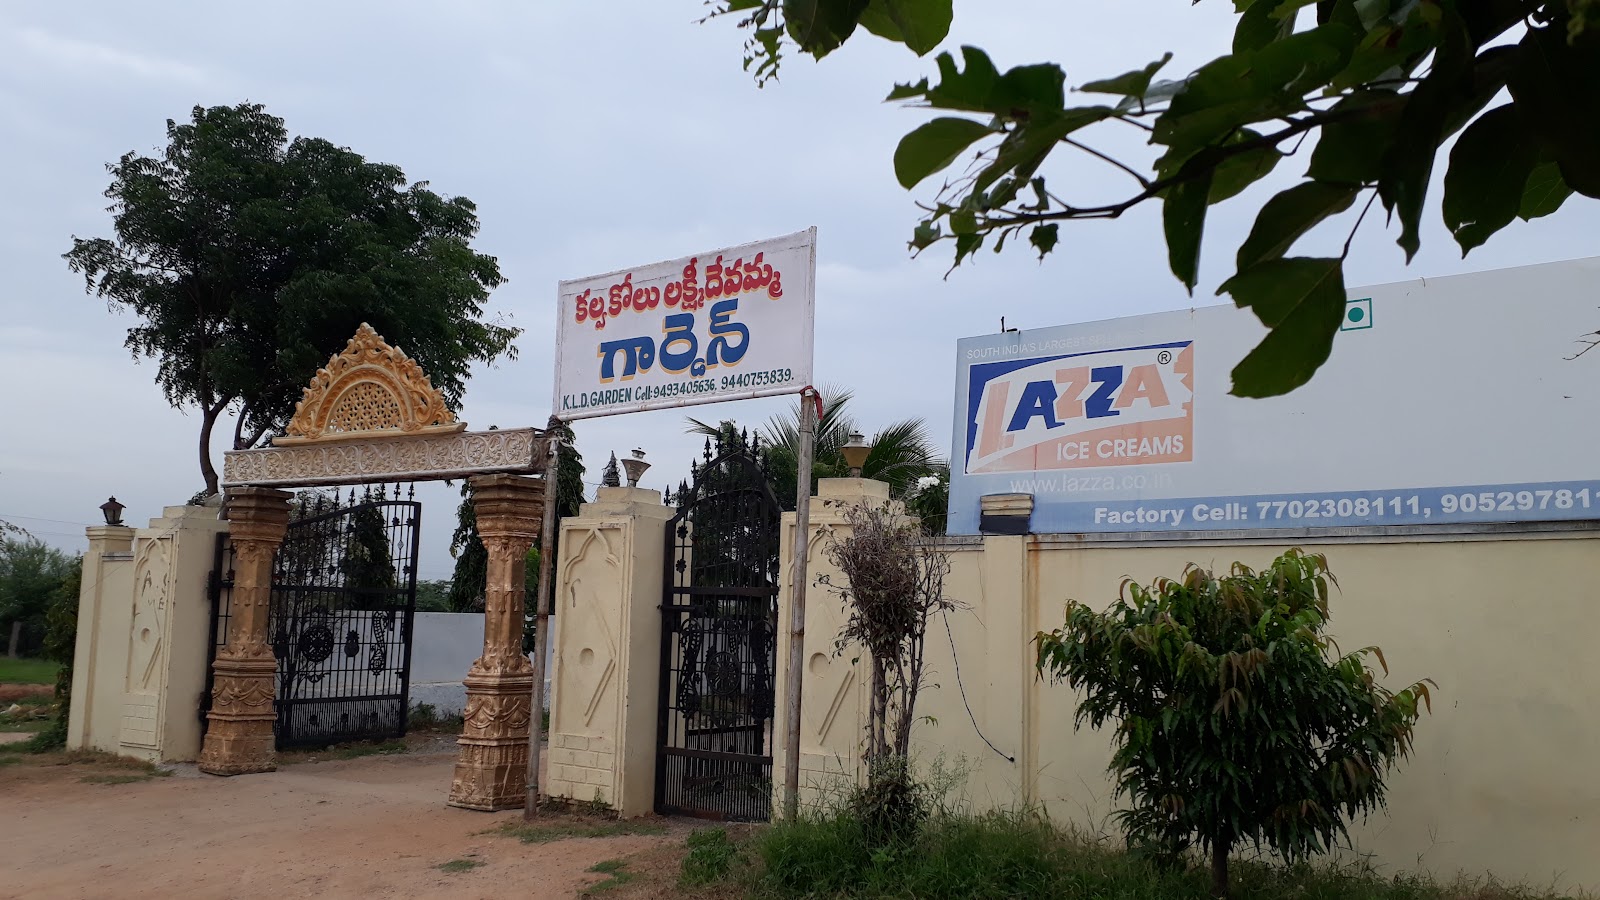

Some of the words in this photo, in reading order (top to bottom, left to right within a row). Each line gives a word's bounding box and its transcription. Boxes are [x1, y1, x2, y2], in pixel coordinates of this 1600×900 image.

[597, 298, 750, 383] గార్డెన్
[967, 347, 1000, 359] SOUTH
[1002, 342, 1036, 355] INDIA'S
[978, 363, 1171, 459] LAZZA
[1056, 441, 1090, 461] ICE
[1096, 434, 1184, 458] CREAMS
[1010, 473, 1172, 493] www.lazza.co.in
[1094, 506, 1185, 526] Factory
[1192, 503, 1248, 522] Cell:
[1256, 495, 1432, 520] 7702308111,
[1441, 488, 1600, 514] 90529781
